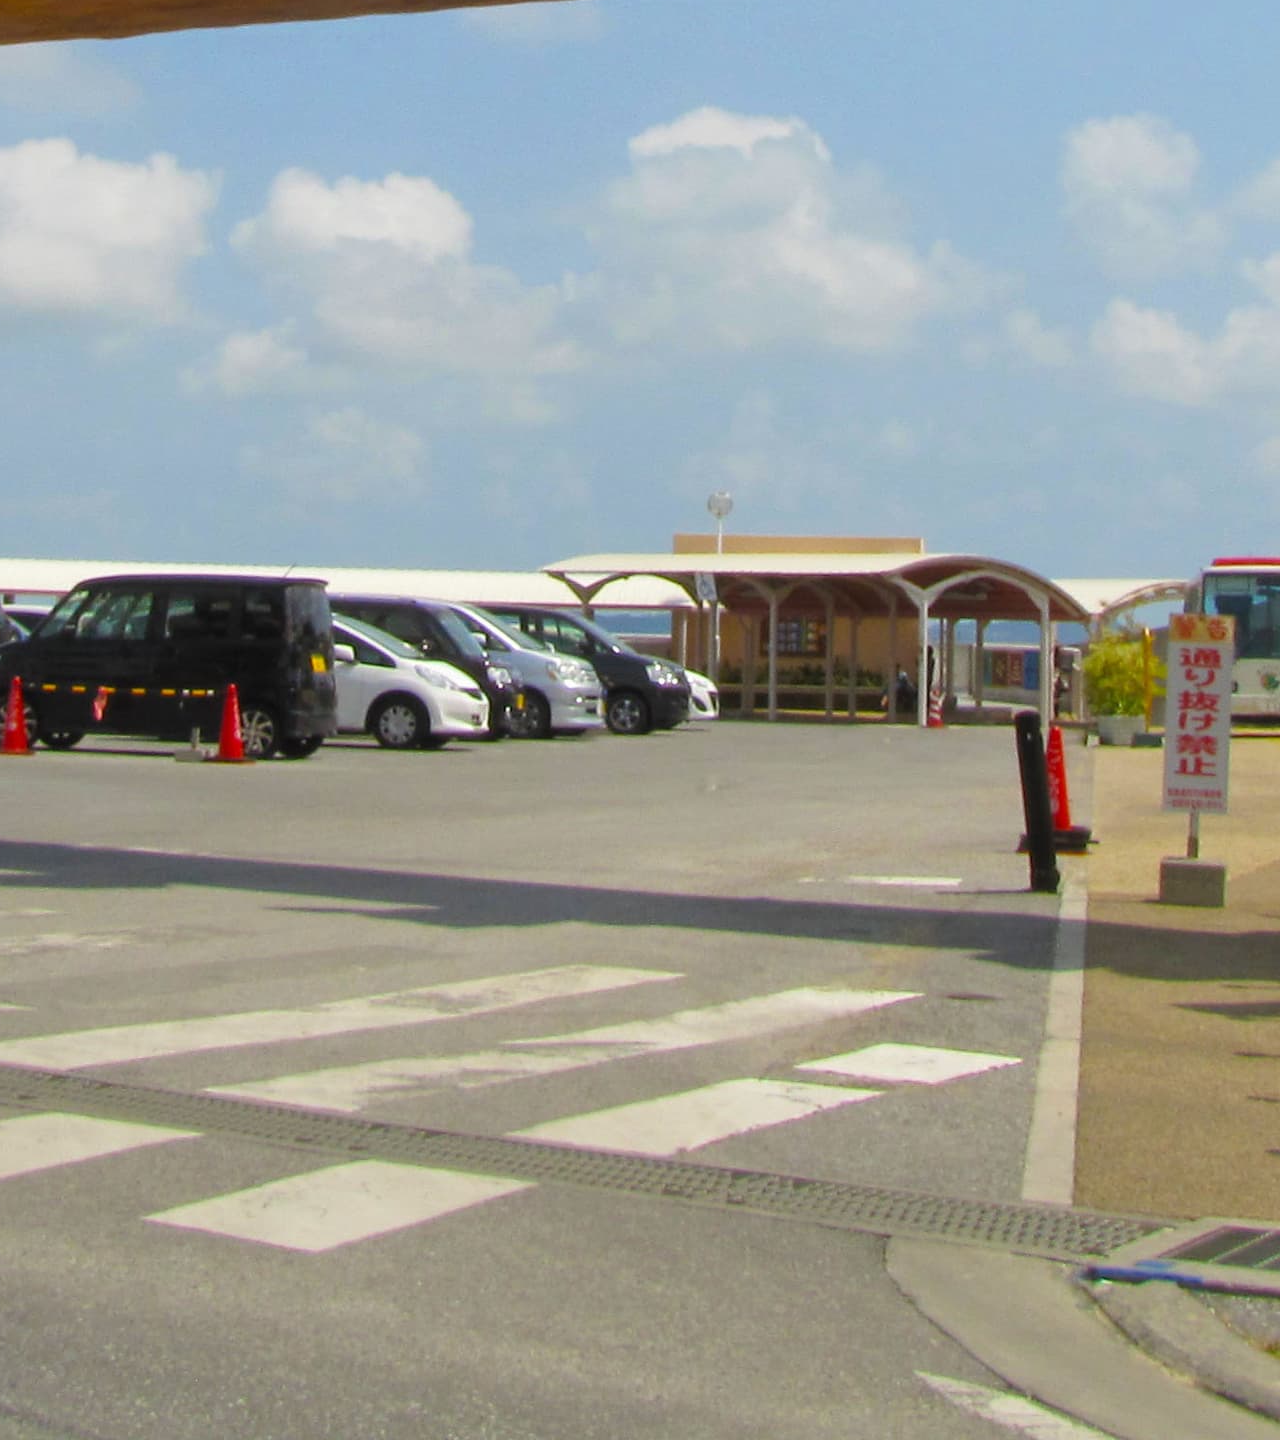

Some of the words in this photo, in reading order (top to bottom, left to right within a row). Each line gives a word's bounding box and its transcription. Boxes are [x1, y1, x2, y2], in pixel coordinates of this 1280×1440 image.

[1174, 647, 1222, 777] 通り抜け禁止
